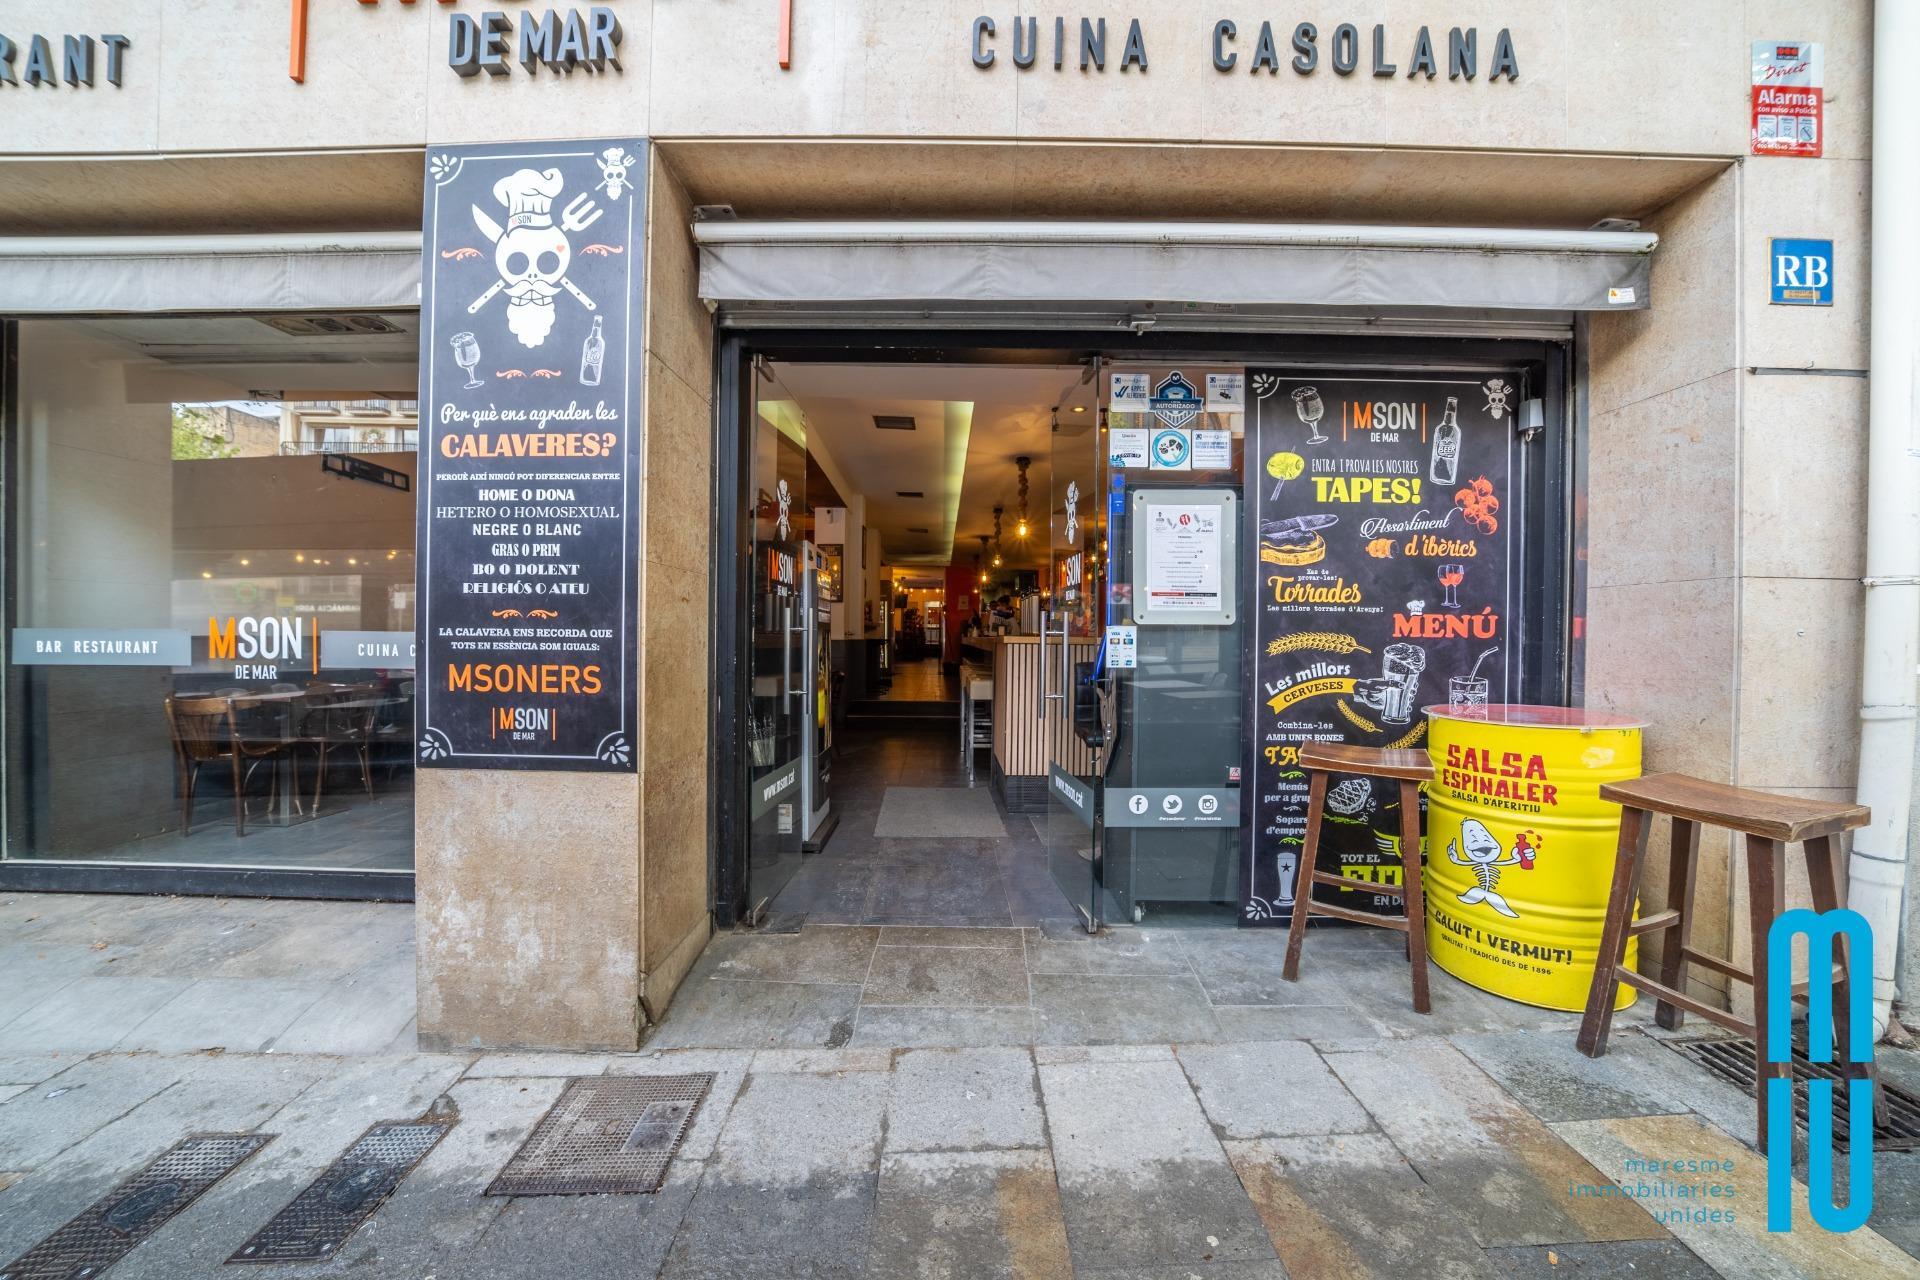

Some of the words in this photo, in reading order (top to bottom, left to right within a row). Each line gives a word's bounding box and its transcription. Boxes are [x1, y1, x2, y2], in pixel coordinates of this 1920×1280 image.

[449, 11, 513, 77] DE
[519, 7, 624, 75] MAR
[972, 16, 1149, 74] CUINA
[1212, 19, 1521, 83] CASOLANA
[1758, 88, 1817, 106] Alarma
[511, 214, 532, 225] SON
[1775, 255, 1828, 288] RB
[441, 403, 470, 424] Per
[472, 403, 498, 429] què
[501, 407, 526, 422] ens
[529, 400, 593, 430] agraden
[595, 400, 619, 422] les
[1354, 401, 1416, 431] MSON
[440, 432, 618, 459] CALAVERES?
[1370, 432, 1381, 443] DE
[1382, 432, 1399, 443] MAR
[1311, 458, 1336, 473] ENTRA
[1340, 459, 1344, 472] I
[1346, 459, 1370, 473] PROVA
[1372, 460, 1384, 473] LES
[1387, 460, 1419, 474] NOSTRES
[436, 472, 469, 481] PERQUÈ
[470, 471, 487, 481] AIXÍ
[489, 471, 515, 481] NINGÚ
[478, 488, 518, 501] HOME
[522, 488, 532, 501] O
[536, 488, 576, 501] DONA
[1311, 476, 1422, 505] TAPES!
[436, 506, 497, 519] HETERO
[500, 506, 511, 519] O
[514, 506, 620, 519] HOMOSEXUAL
[472, 523, 519, 536] NEGRE
[522, 523, 532, 536] O
[536, 523, 582, 537] BLANC
[1359, 507, 1464, 539] Assortiment
[491, 543, 519, 557] GRAS
[522, 543, 530, 557] O
[532, 543, 561, 557] PRIM
[472, 563, 495, 575] BO
[499, 563, 511, 575] O
[515, 563, 580, 576] DOLENT
[462, 579, 533, 594] RELIGIÓS
[535, 582, 547, 594] O
[549, 582, 591, 595] ATEU
[1267, 575, 1362, 604] Torrades
[1267, 604, 1280, 612] Les
[1282, 604, 1311, 612] millors
[1314, 605, 1346, 613] torrades
[1348, 605, 1384, 614] d'Arenys!
[1392, 606, 1499, 639] MENÚ
[208, 616, 303, 660] MSON
[439, 627, 453, 637] LA
[455, 627, 511, 637] CALAVERA
[513, 628, 535, 638] ENS
[536, 628, 588, 638] RECORDA
[589, 629, 613, 638] QUE
[36, 639, 63, 654] BAR
[73, 639, 159, 655] RESTAURANT
[358, 643, 399, 657] CUINA
[451, 641, 476, 650] TOTS
[478, 642, 491, 650] EN
[493, 640, 538, 651] ESSÈNCIA
[540, 642, 561, 651] SOM
[563, 642, 601, 652] IGUALS:
[235, 664, 251, 680] DE
[252, 664, 277, 680] MAR
[448, 663, 602, 695] MSONERS
[1264, 675, 1293, 697] Les
[1295, 661, 1352, 683] millors
[1283, 681, 1344, 704] CERVESES
[500, 707, 548, 731] MSON
[1277, 721, 1334, 730] Combina-les
[513, 731, 522, 741] DE
[522, 731, 535, 741] MAR
[1266, 733, 1287, 741] AMB
[1289, 733, 1312, 741] UNES
[1313, 733, 1345, 742] BONES
[1446, 743, 1548, 781] SALSA
[1277, 782, 1309, 791] Menús
[1442, 768, 1558, 806] ESPINALER
[1264, 794, 1281, 803] per
[1282, 794, 1290, 802] a
[1451, 789, 1479, 804] SALSA
[1483, 797, 1541, 813] D'APERITIU
[1275, 814, 1308, 826] Sopars
[1340, 854, 1364, 863] TOT
[1366, 854, 1381, 863] EL
[1373, 895, 1390, 906] EN
[1434, 910, 1473, 940] SALUT
[1476, 930, 1481, 943] I
[1486, 933, 1573, 966] VERMUT!
[1501, 958, 1516, 968] DES
[1518, 962, 1529, 971] DE
